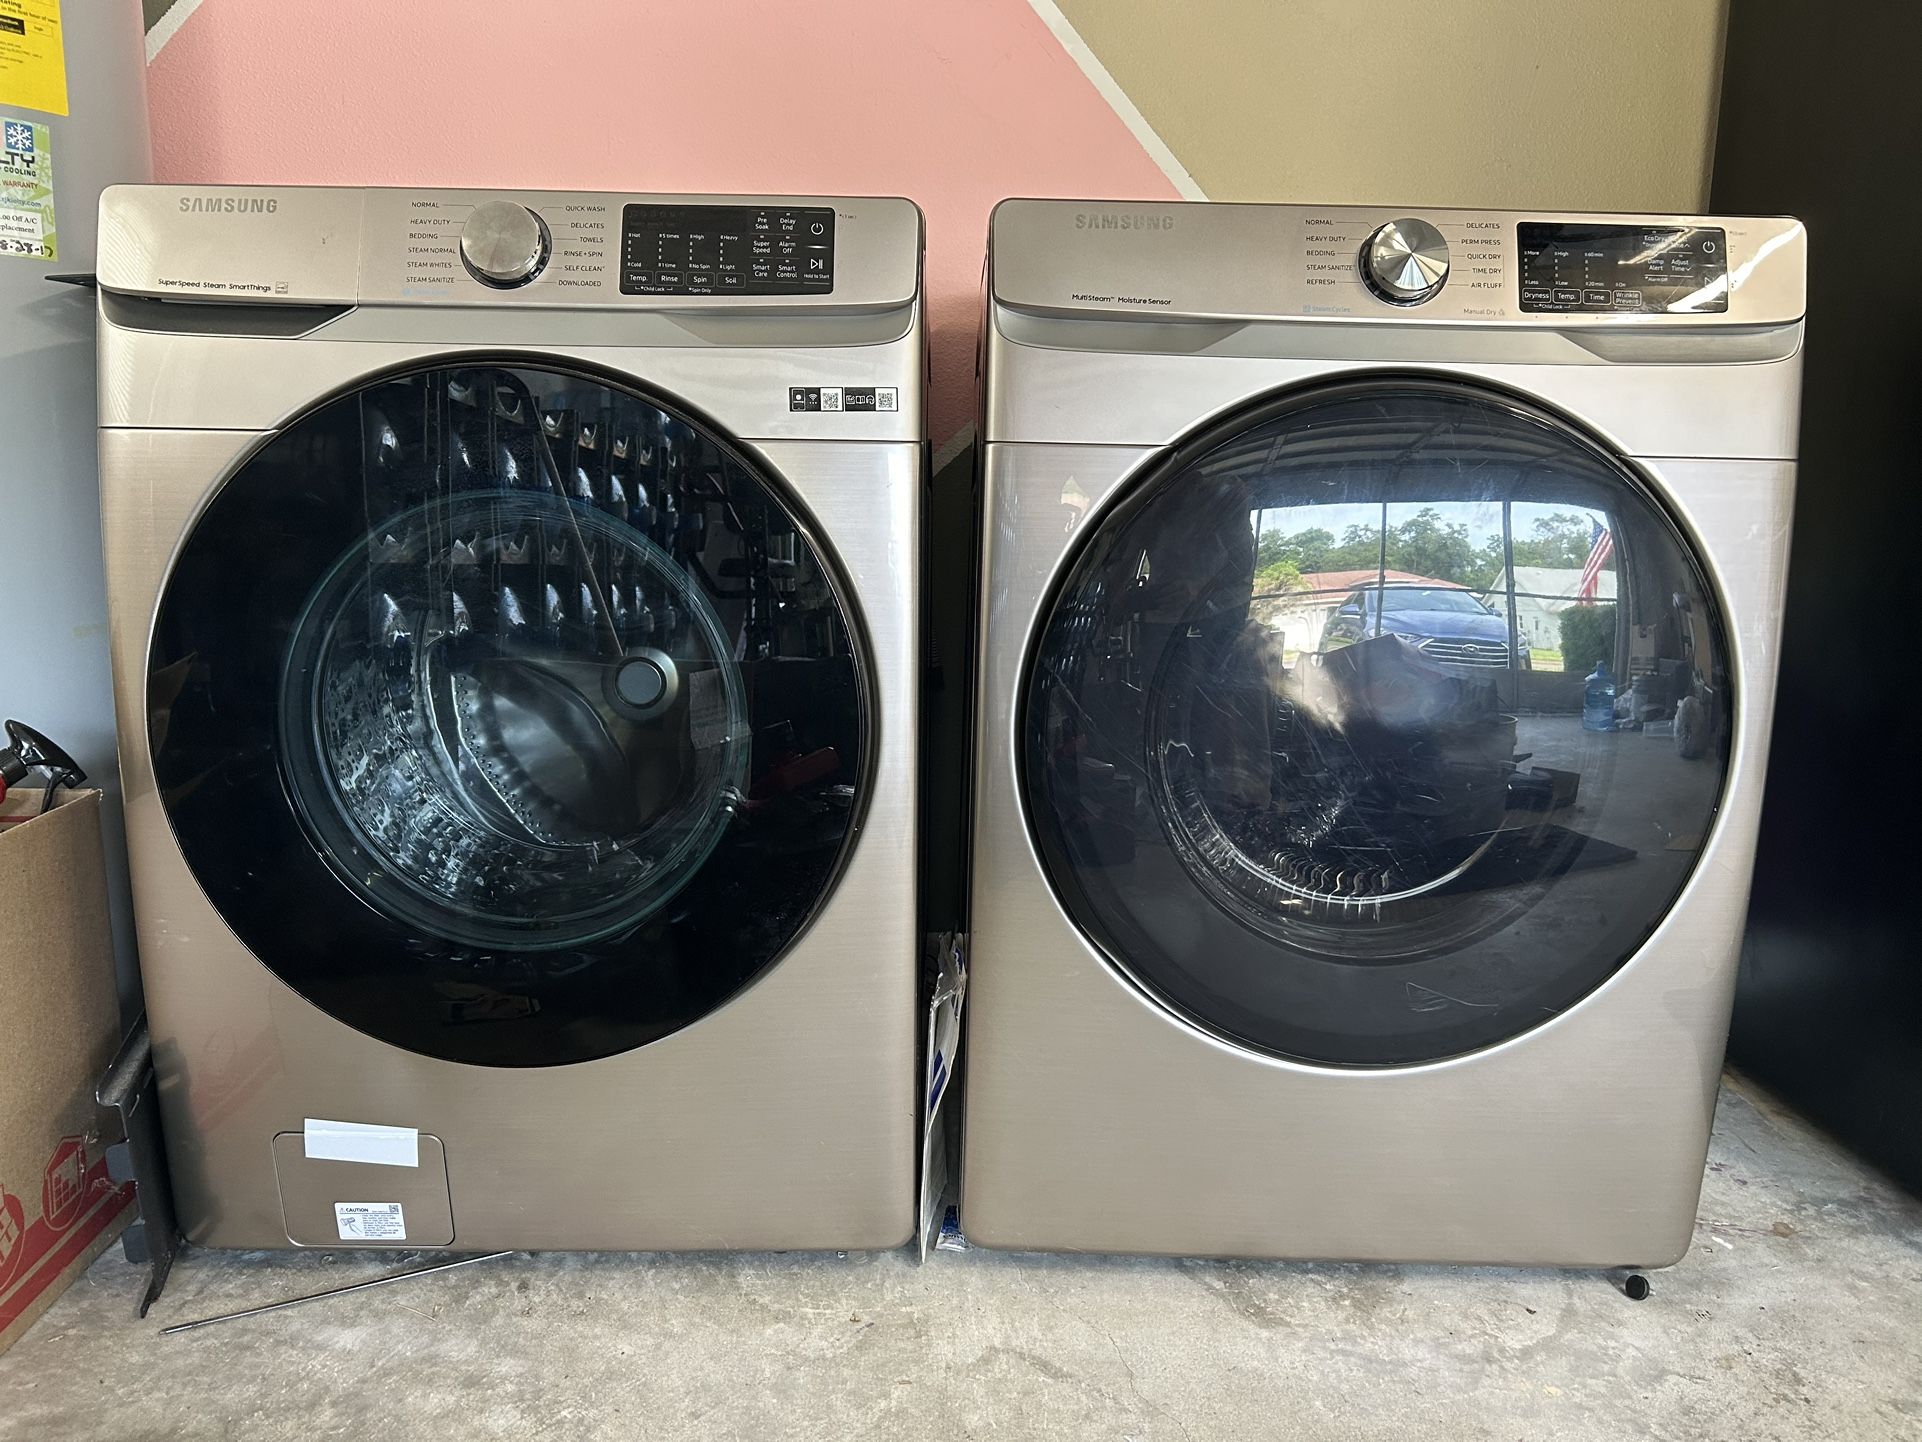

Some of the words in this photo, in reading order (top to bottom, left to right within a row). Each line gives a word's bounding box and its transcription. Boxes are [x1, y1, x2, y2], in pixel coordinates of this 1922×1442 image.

[3, 166, 37, 177] COOLING
[3, 180, 39, 190] WARRANTY
[179, 197, 278, 213] SAMSUNG
[779, 217, 796, 225] Delay
[1075, 213, 1174, 230] SAMSUNG
[158, 278, 201, 288] SuperSpeed
[203, 281, 226, 289] Steam
[228, 283, 271, 293] SmartThings
[558, 279, 602, 287] DOWNLOADED
[1117, 296, 1147, 305] Moisture
[1148, 298, 1172, 306] Sensor
[1486, 308, 1497, 316] Dry
